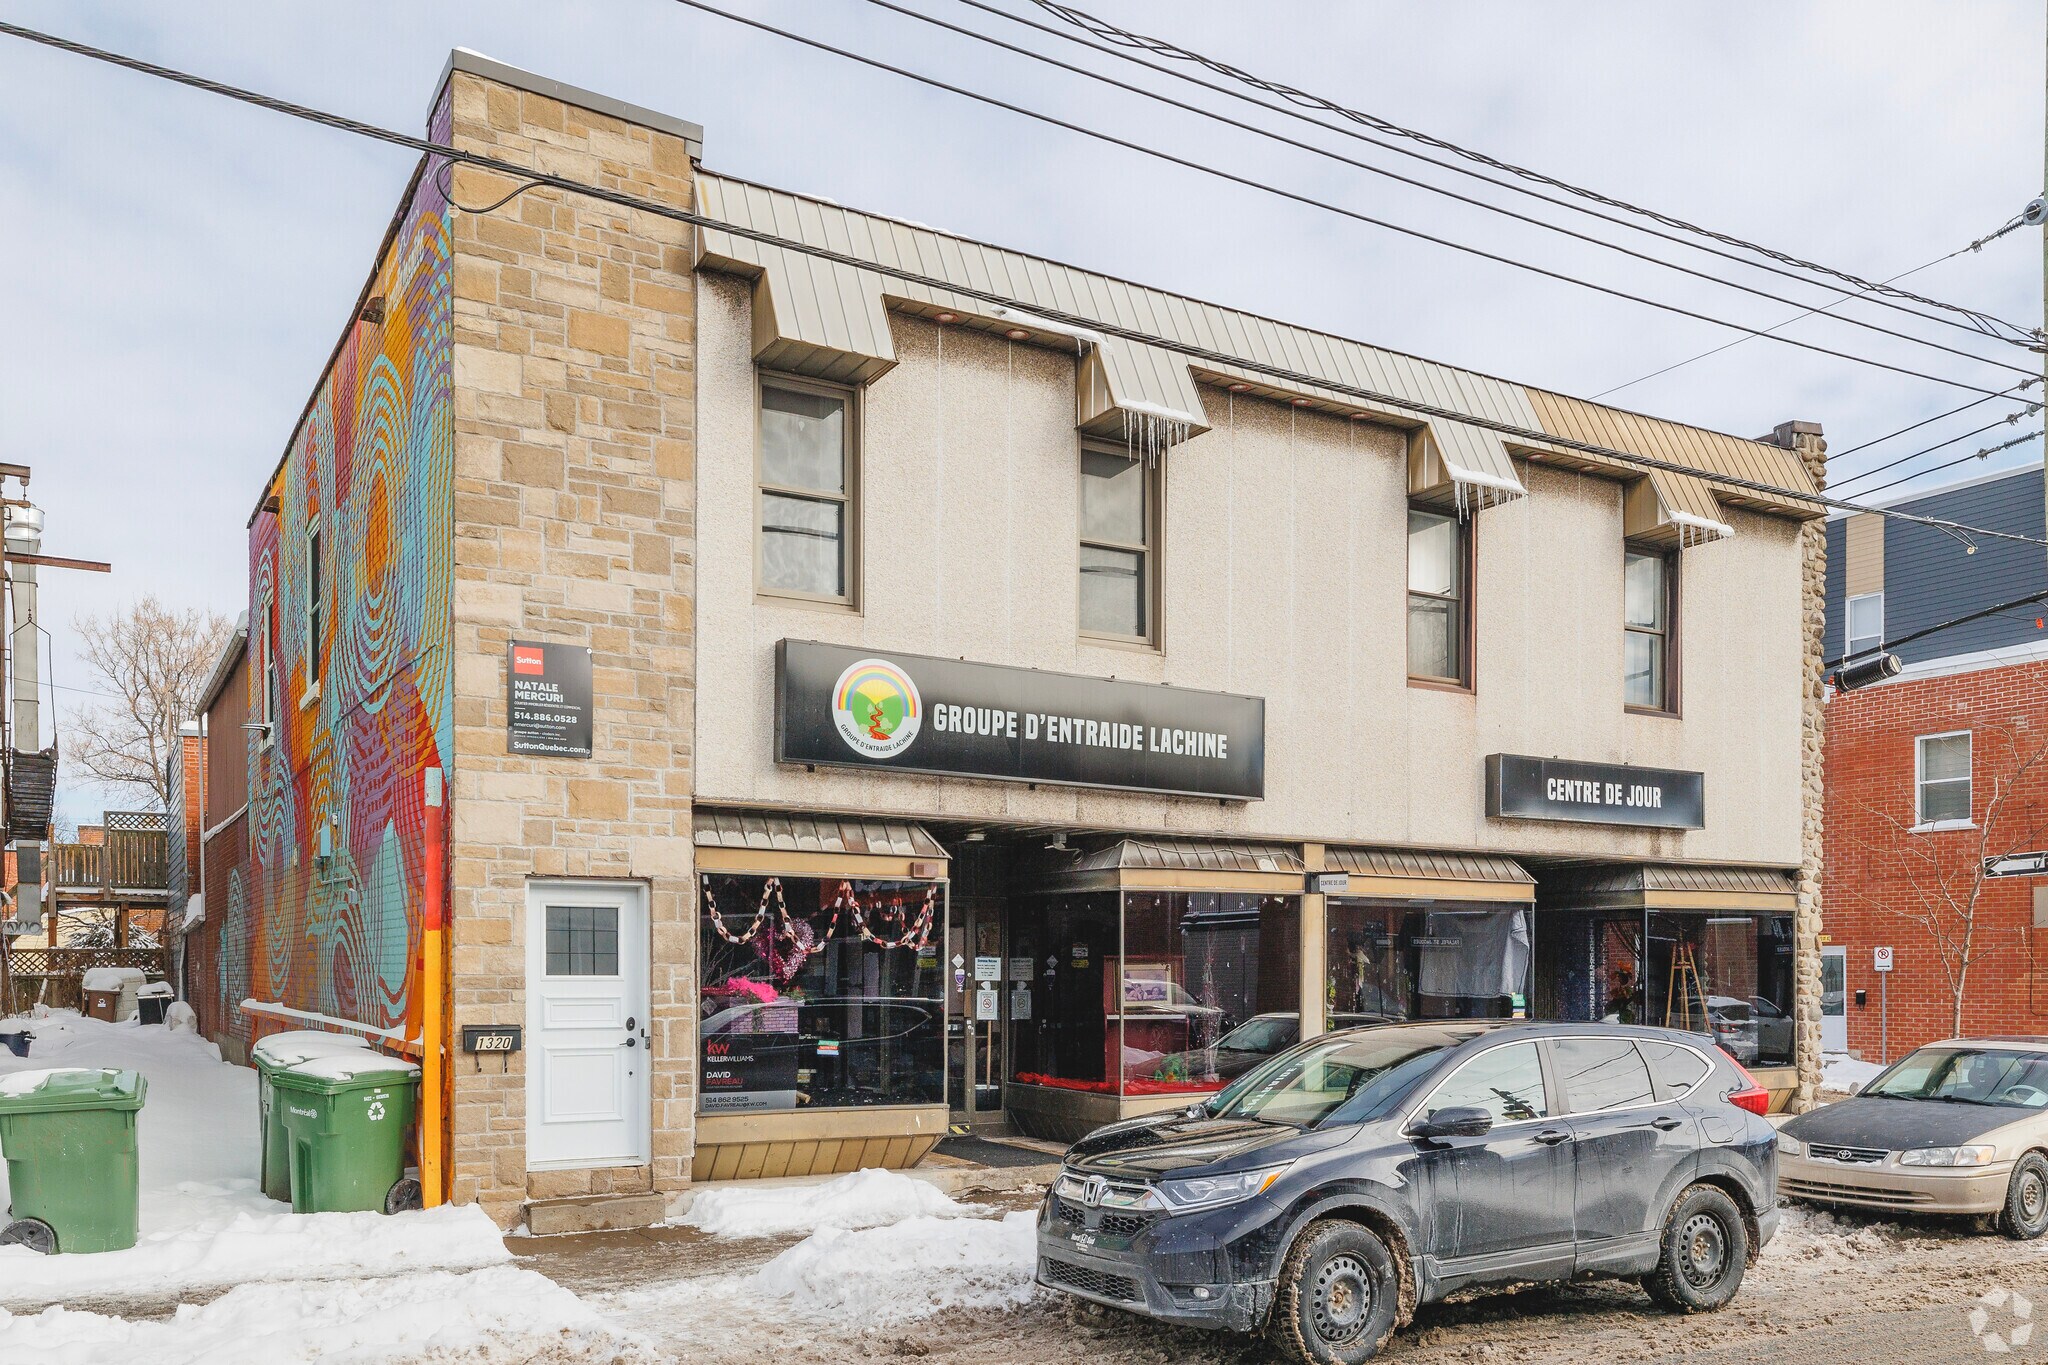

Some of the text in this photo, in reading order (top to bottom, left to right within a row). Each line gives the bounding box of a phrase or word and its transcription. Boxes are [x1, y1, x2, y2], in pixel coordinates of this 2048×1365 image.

[516, 656, 542, 665] Sutton
[514, 680, 559, 692] NATALE
[514, 690, 564, 703] MERCURI
[514, 711, 578, 724] 514.886.0528
[840, 723, 914, 752] GROUPE D'ENTRAIDE LACHINE
[934, 703, 1227, 759] GROUPE D'ENTRAIDE LACHINE
[513, 741, 586, 754] SuttonQuebec.com
[1547, 777, 1662, 809] CENTRE DE JOUR
[479, 1037, 511, 1049] 1320
[707, 1039, 730, 1055] kw
[706, 1071, 731, 1079] DAVID
[290, 1105, 311, 1117] Montréal
